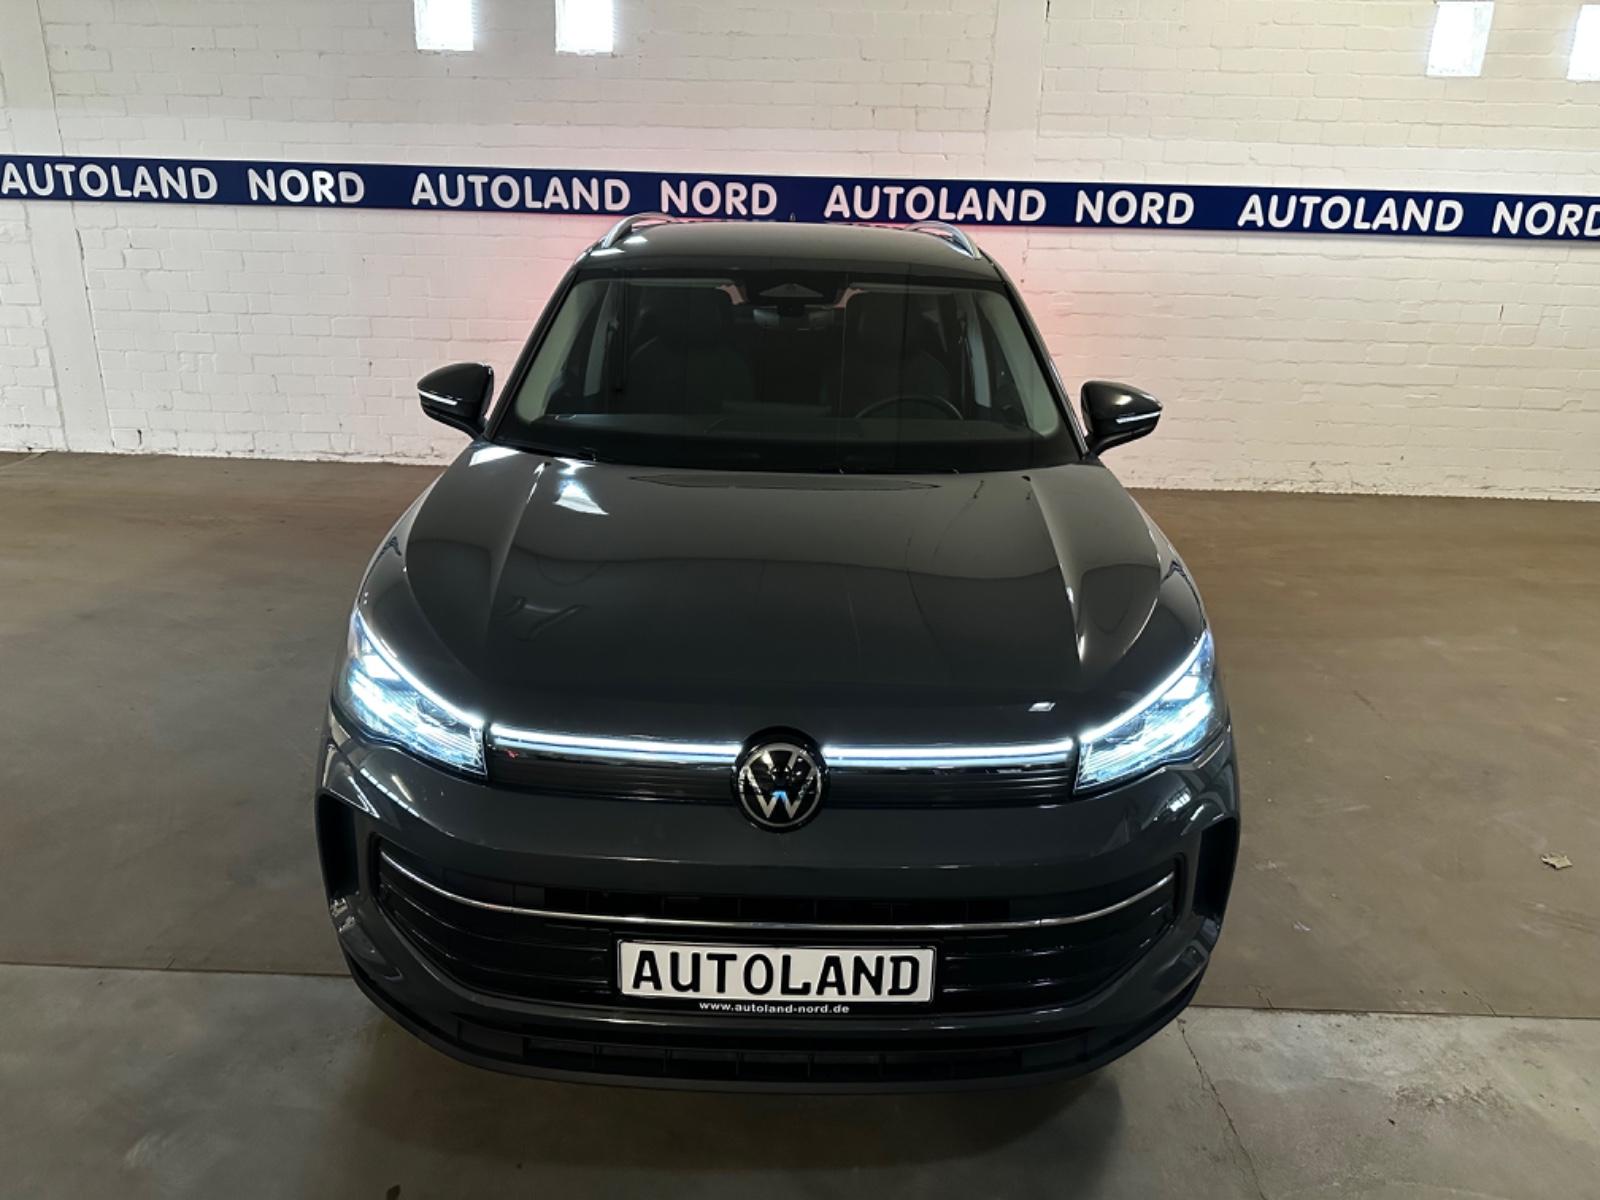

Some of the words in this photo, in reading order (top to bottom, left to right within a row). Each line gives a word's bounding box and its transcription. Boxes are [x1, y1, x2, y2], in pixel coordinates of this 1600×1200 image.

[1, 162, 218, 200] AUTOLAND
[247, 168, 365, 204] NORD
[411, 172, 631, 212] AUTOLAND
[660, 179, 778, 216] NORD
[824, 184, 1047, 222] AUTOLAND
[1075, 189, 1195, 226] NORD
[1237, 194, 1464, 232] AUTOLAND
[632, 950, 920, 995] AUTOLAND
[699, 1001, 850, 1014] www.autoland-nord.de
